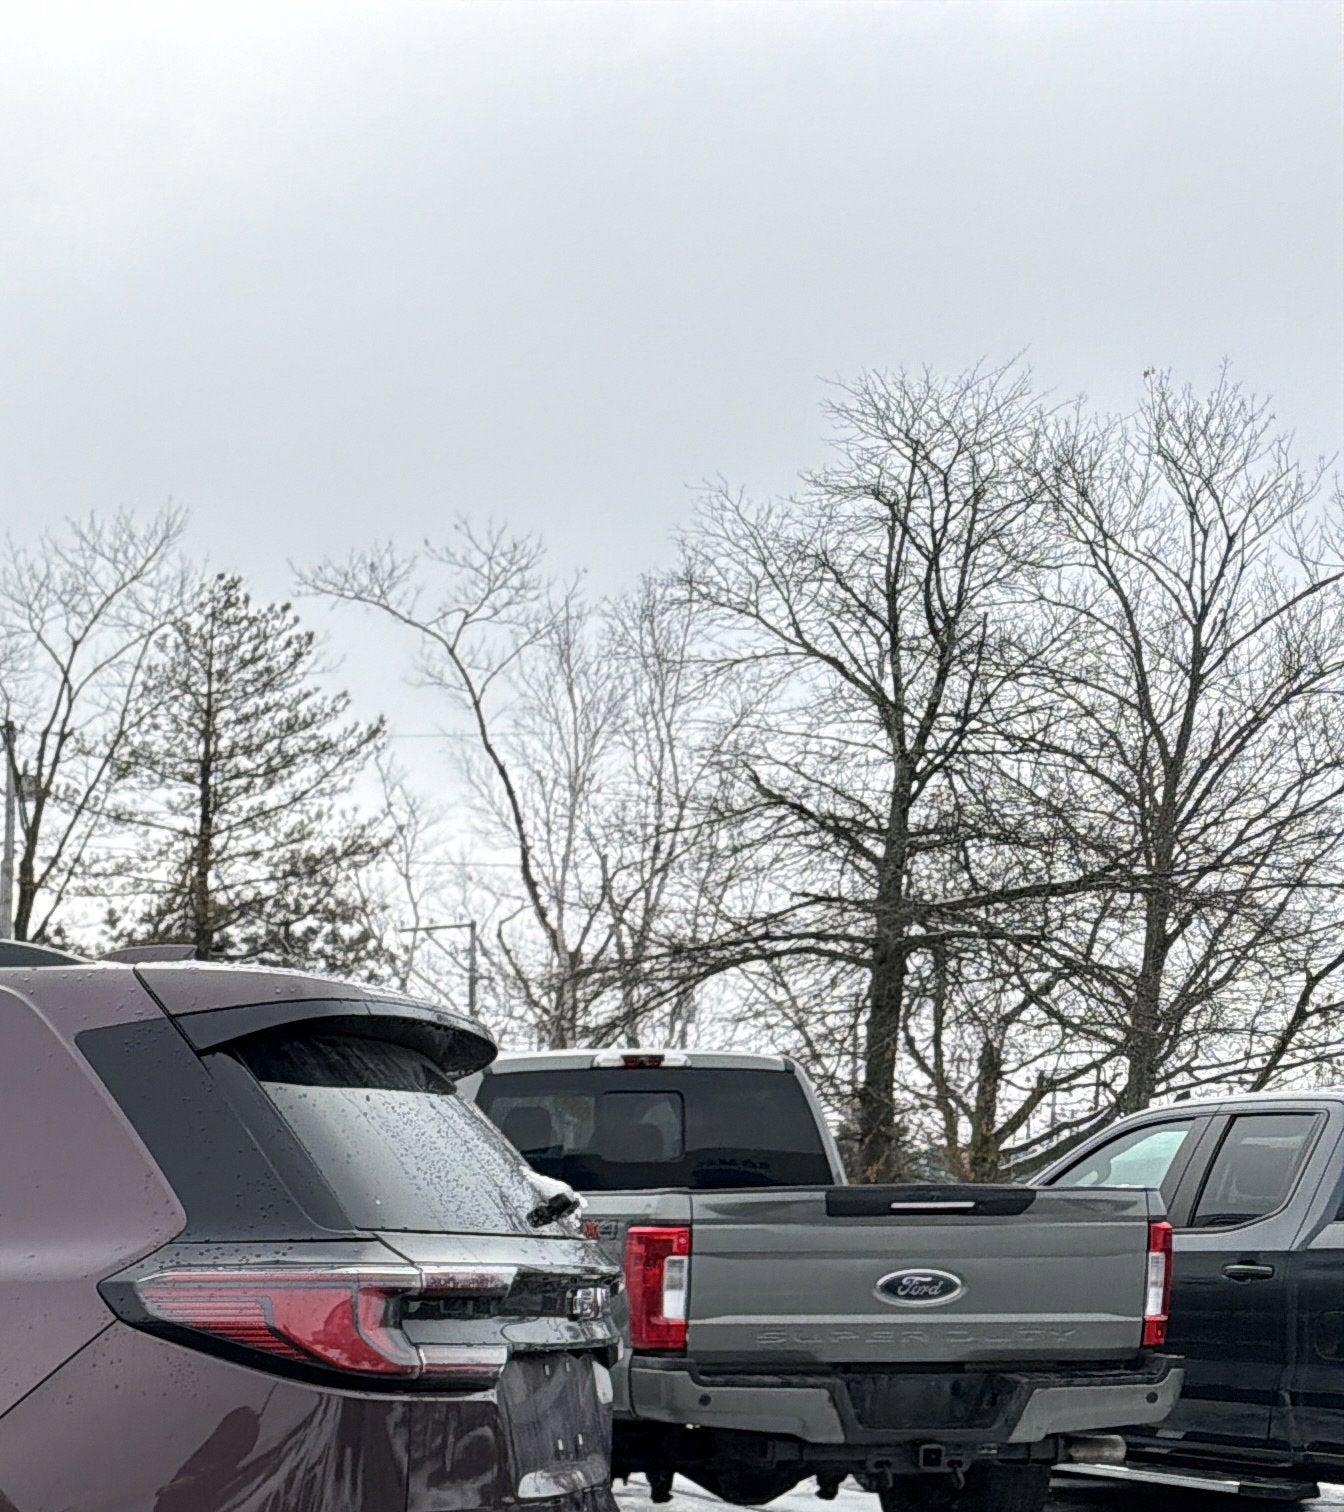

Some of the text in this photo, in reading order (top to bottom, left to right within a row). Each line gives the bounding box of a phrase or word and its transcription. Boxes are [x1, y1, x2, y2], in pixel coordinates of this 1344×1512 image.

[897, 1275, 944, 1297] Ford
[755, 1327, 1077, 1344] SUPER DUTY
